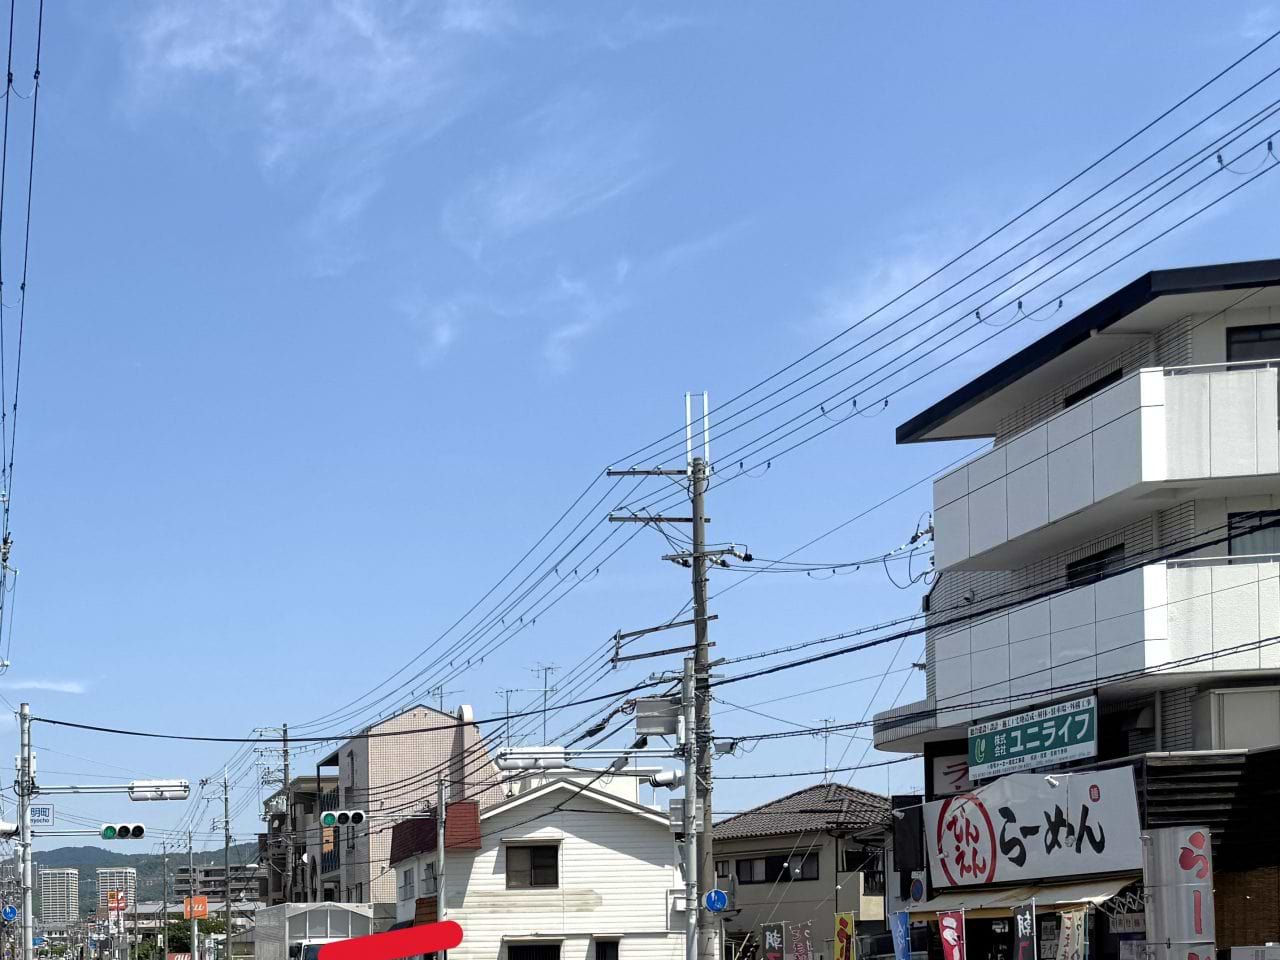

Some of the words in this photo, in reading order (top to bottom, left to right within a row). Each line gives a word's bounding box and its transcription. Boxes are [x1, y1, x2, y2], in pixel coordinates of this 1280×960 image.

[1009, 714, 1090, 753] ユニライフ
[30, 807, 50, 818] 明町
[998, 804, 1106, 868] らーめん
